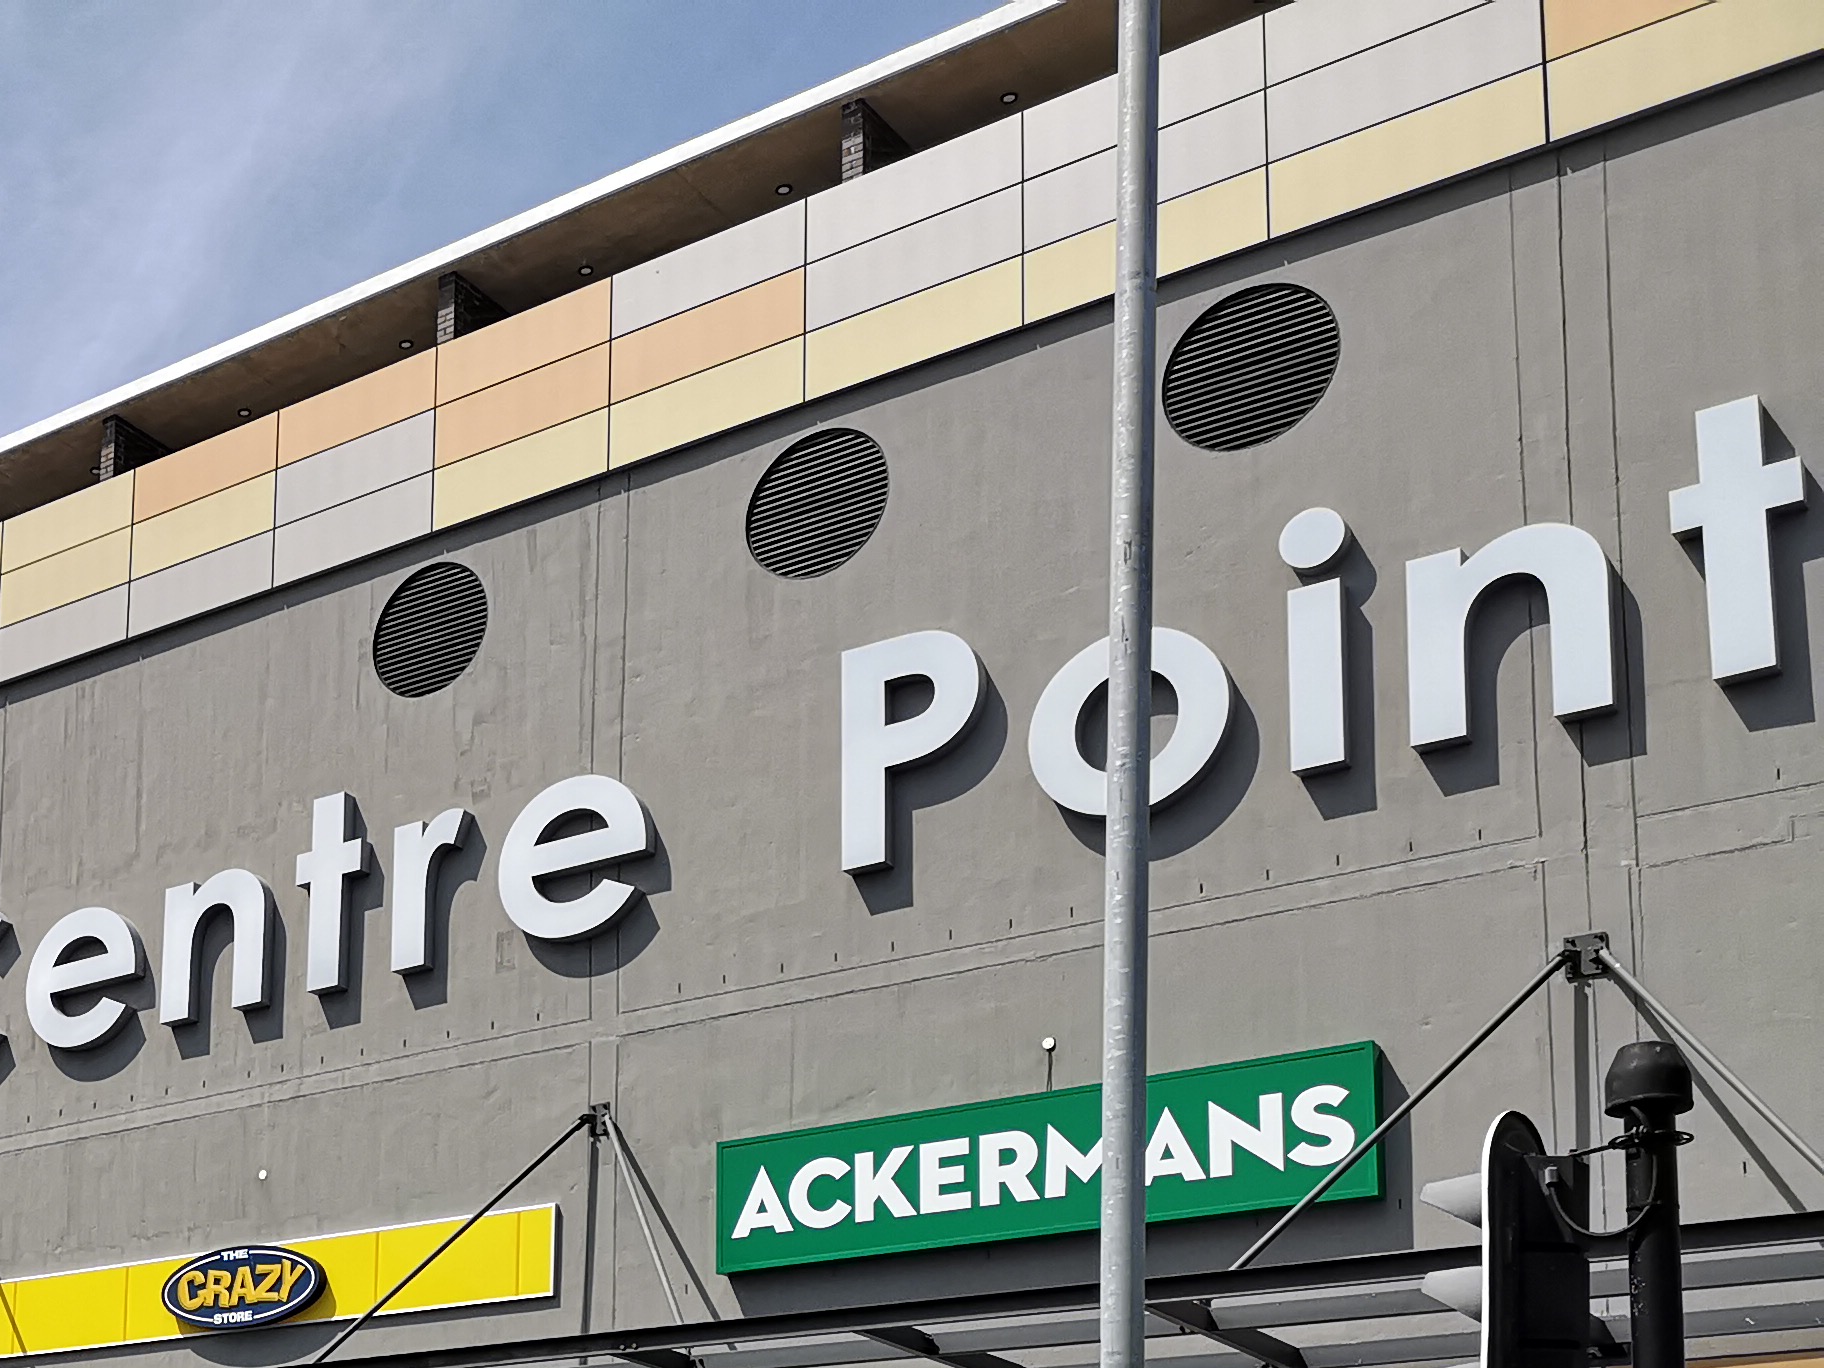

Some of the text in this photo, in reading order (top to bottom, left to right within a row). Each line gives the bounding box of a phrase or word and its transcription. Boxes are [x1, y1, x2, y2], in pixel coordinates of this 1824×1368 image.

[841, 394, 1806, 874] Point
[731, 1084, 1357, 1240] ACKERMANS
[221, 1249, 249, 1261] THE
[177, 1258, 306, 1311] CRAZY
[213, 1310, 253, 1325] STORE
